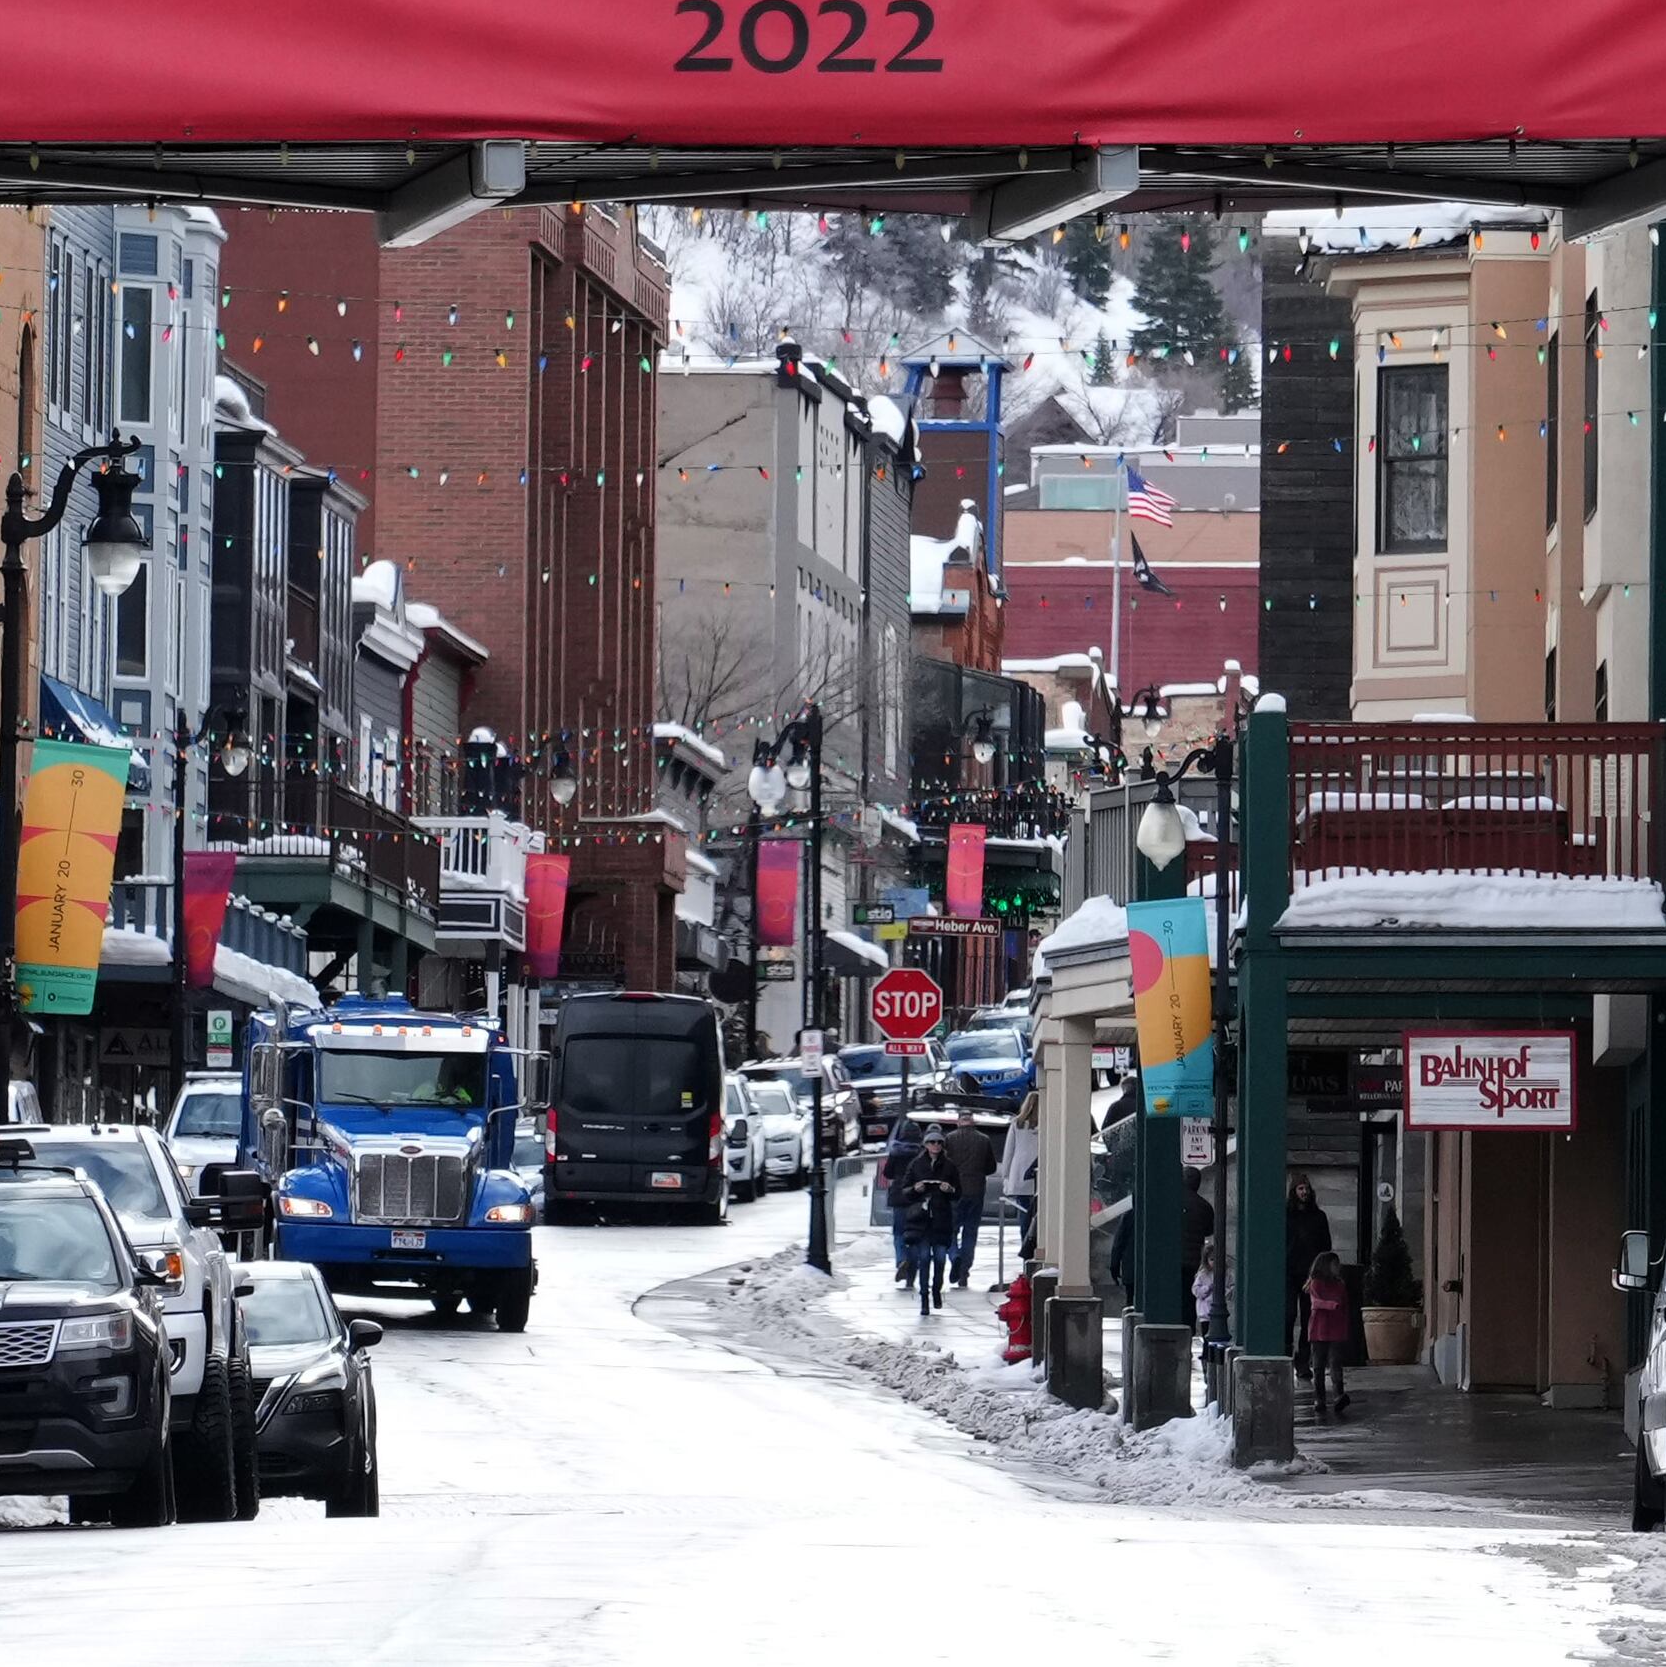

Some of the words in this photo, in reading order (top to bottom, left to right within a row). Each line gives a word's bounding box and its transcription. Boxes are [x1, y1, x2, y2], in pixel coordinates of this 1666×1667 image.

[71, 769, 85, 788] 30
[57, 860, 70, 878] 20
[48, 883, 67, 952] JANUARY
[935, 919, 970, 932] Heber
[972, 922, 999, 934] Ave.
[1163, 920, 1174, 935] 30
[875, 991, 937, 1019] STOP
[1170, 994, 1181, 1008] 20
[888, 1044, 903, 1053] ALL
[906, 1044, 924, 1053] WAY
[1171, 1015, 1187, 1069] JANUARY
[1183, 1126, 1211, 1135] PARKIN
[1191, 1136, 1203, 1144] ANY
